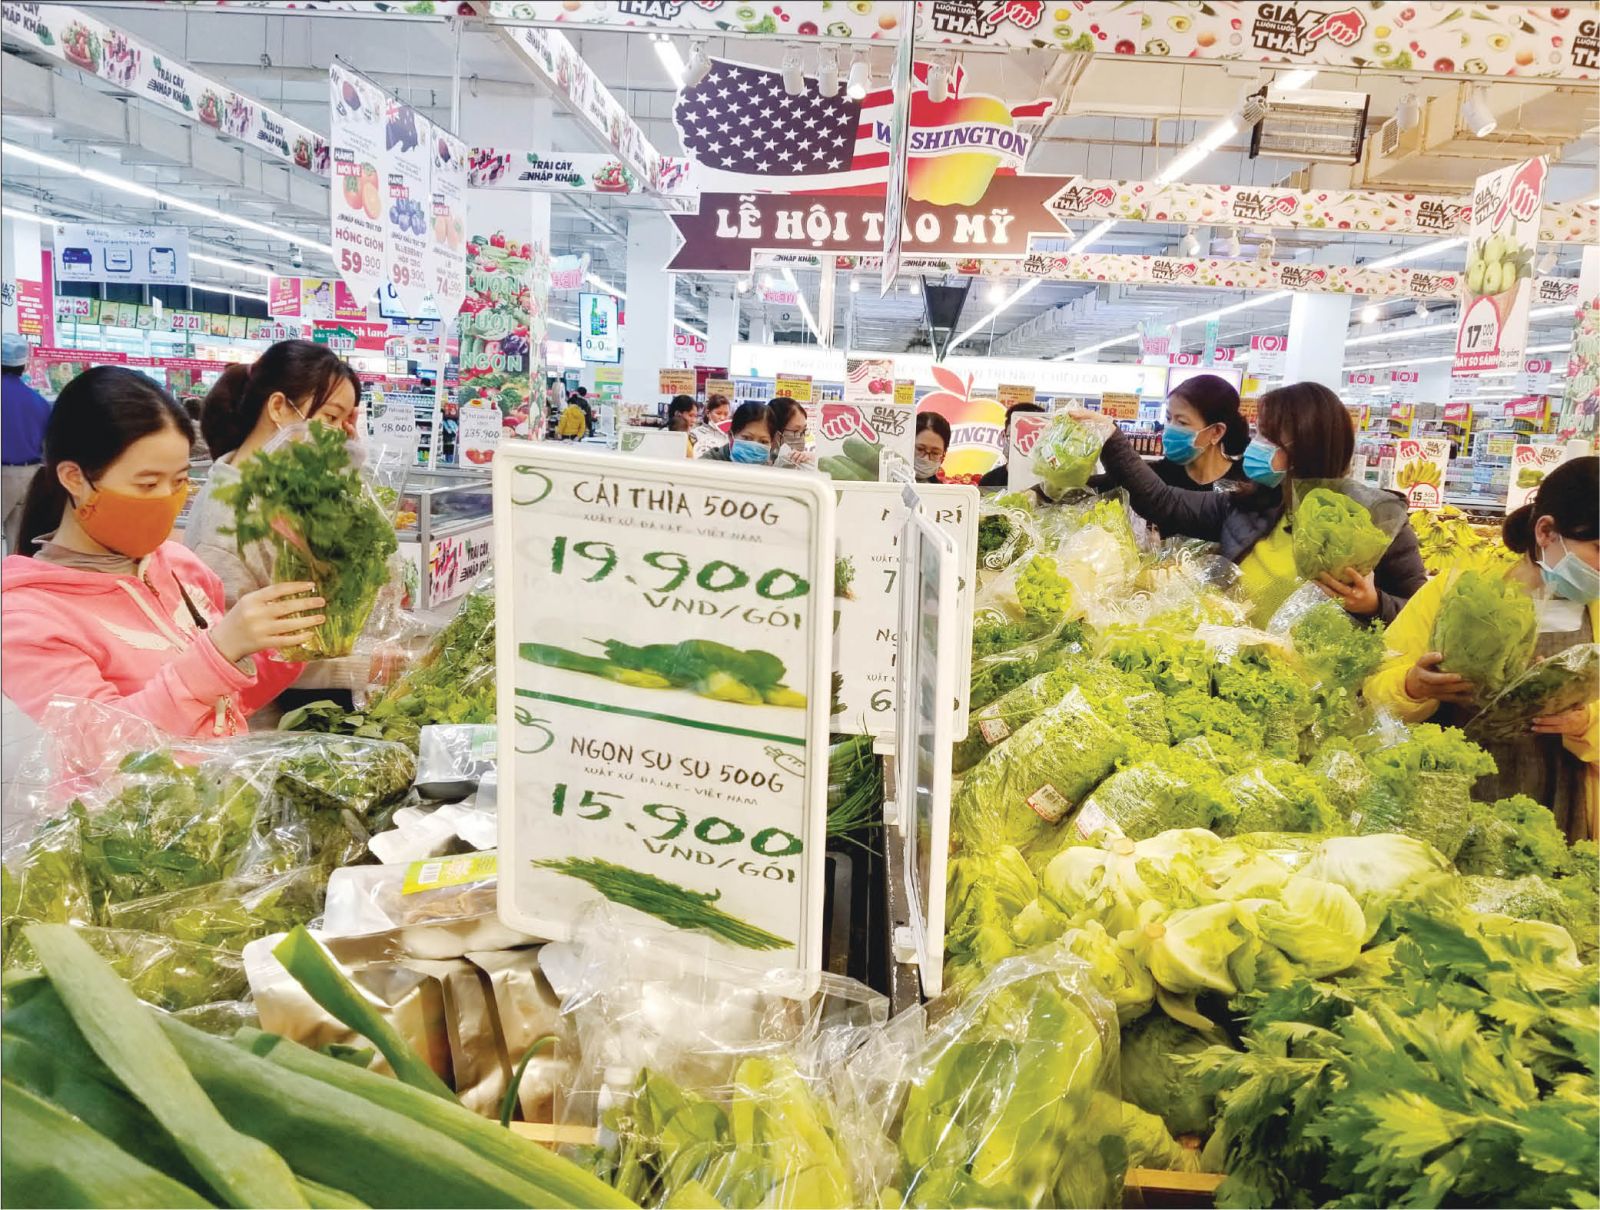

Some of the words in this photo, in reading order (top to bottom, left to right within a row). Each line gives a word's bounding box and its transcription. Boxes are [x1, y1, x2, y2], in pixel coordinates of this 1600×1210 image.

[875, 120, 1029, 156] WSHINGTON
[532, 160, 554, 171] TRÁI
[335, 226, 362, 245] HỒNG
[716, 196, 762, 239] LỄ
[774, 203, 850, 247] HỘI
[862, 212, 941, 243] TO
[955, 208, 1014, 246] MỸ
[76, 300, 89, 315] 23
[172, 315, 184, 328] 22
[188, 317, 199, 329] 21
[260, 328, 271, 338] 20
[274, 328, 285, 339] 19
[1467, 325, 1482, 348] 17
[573, 474, 619, 508] CẢI
[629, 481, 692, 518] THÌA
[703, 495, 780, 526] 500G
[1413, 491, 1423, 501] 15
[551, 535, 810, 600] 19.900
[643, 591, 802, 630] VND/GÓI
[570, 735, 634, 766] NGỌN
[641, 749, 672, 771] SU
[680, 756, 710, 780] SU
[720, 764, 785, 794] 500G
[552, 783, 804, 857] 15.900
[643, 838, 796, 883] VND/GÓI
